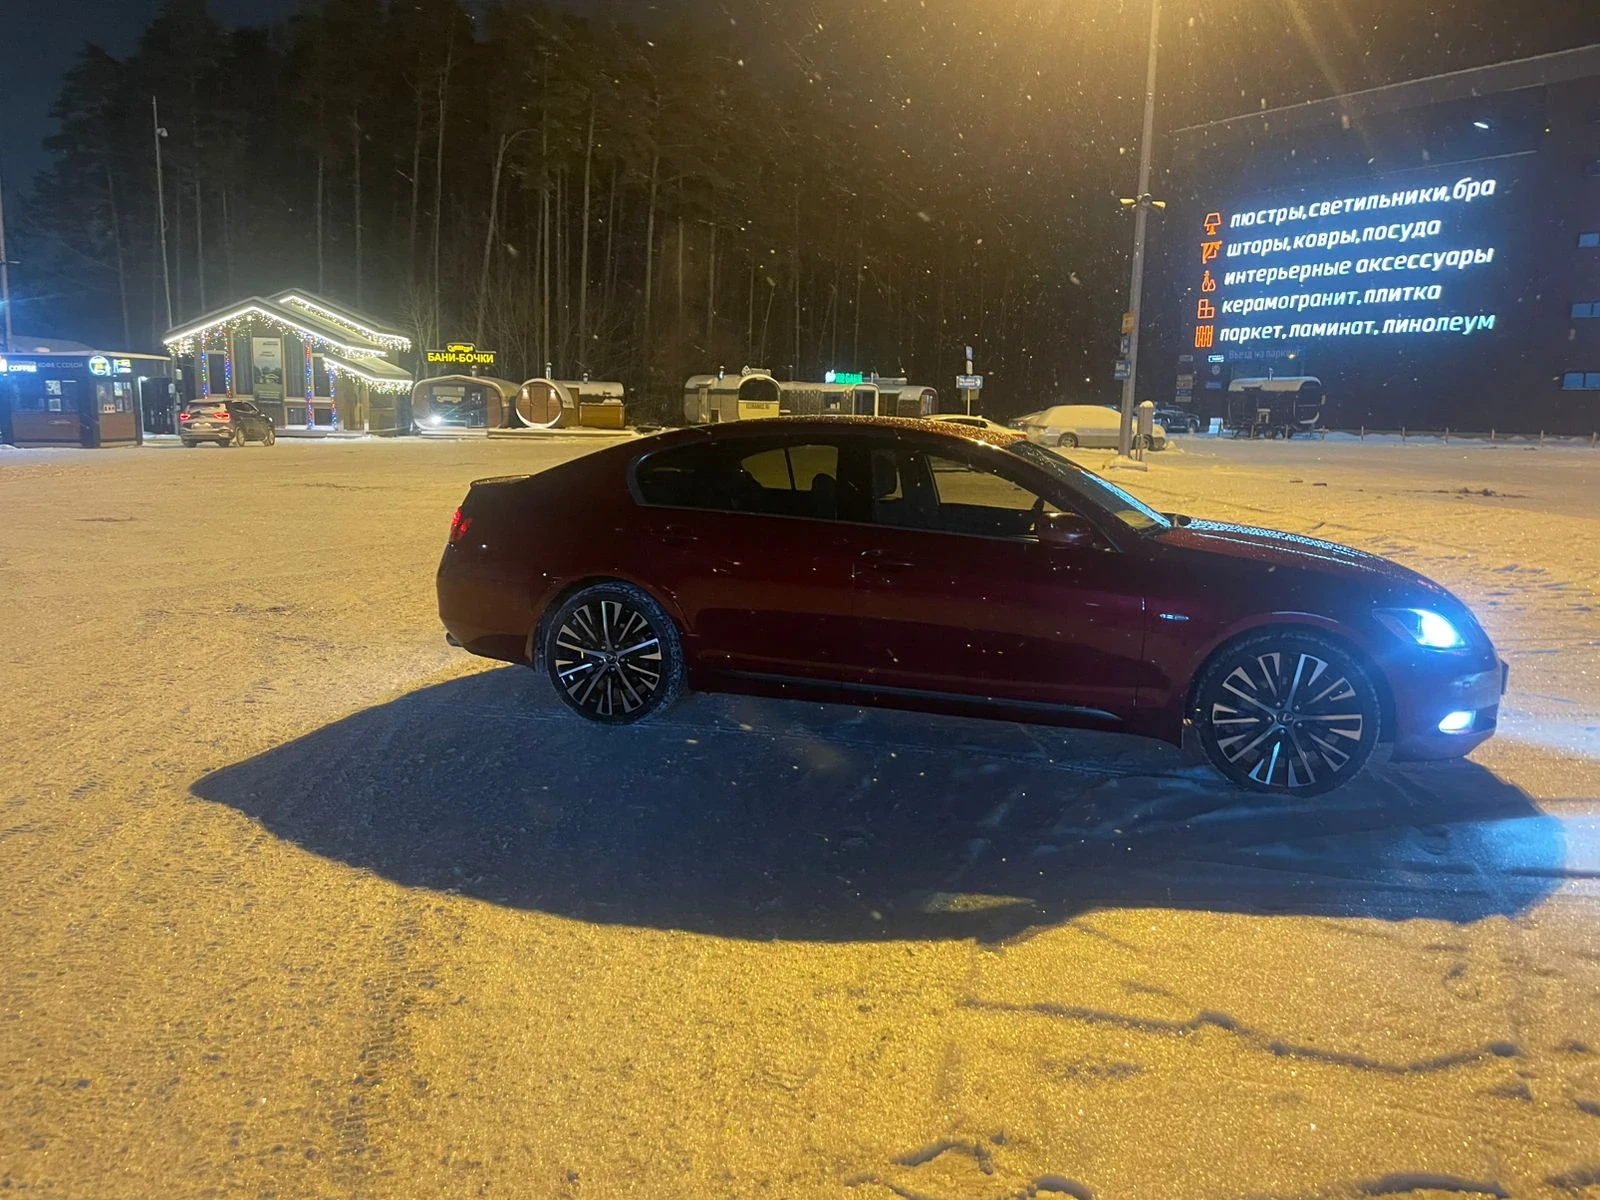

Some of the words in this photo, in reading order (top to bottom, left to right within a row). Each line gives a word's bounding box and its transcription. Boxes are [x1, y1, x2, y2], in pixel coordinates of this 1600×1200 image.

[1224, 260, 1352, 286] интерьерные
[1355, 247, 1495, 274] аксессуары
[427, 352, 494, 364] БАНИ-БОЧКИ
